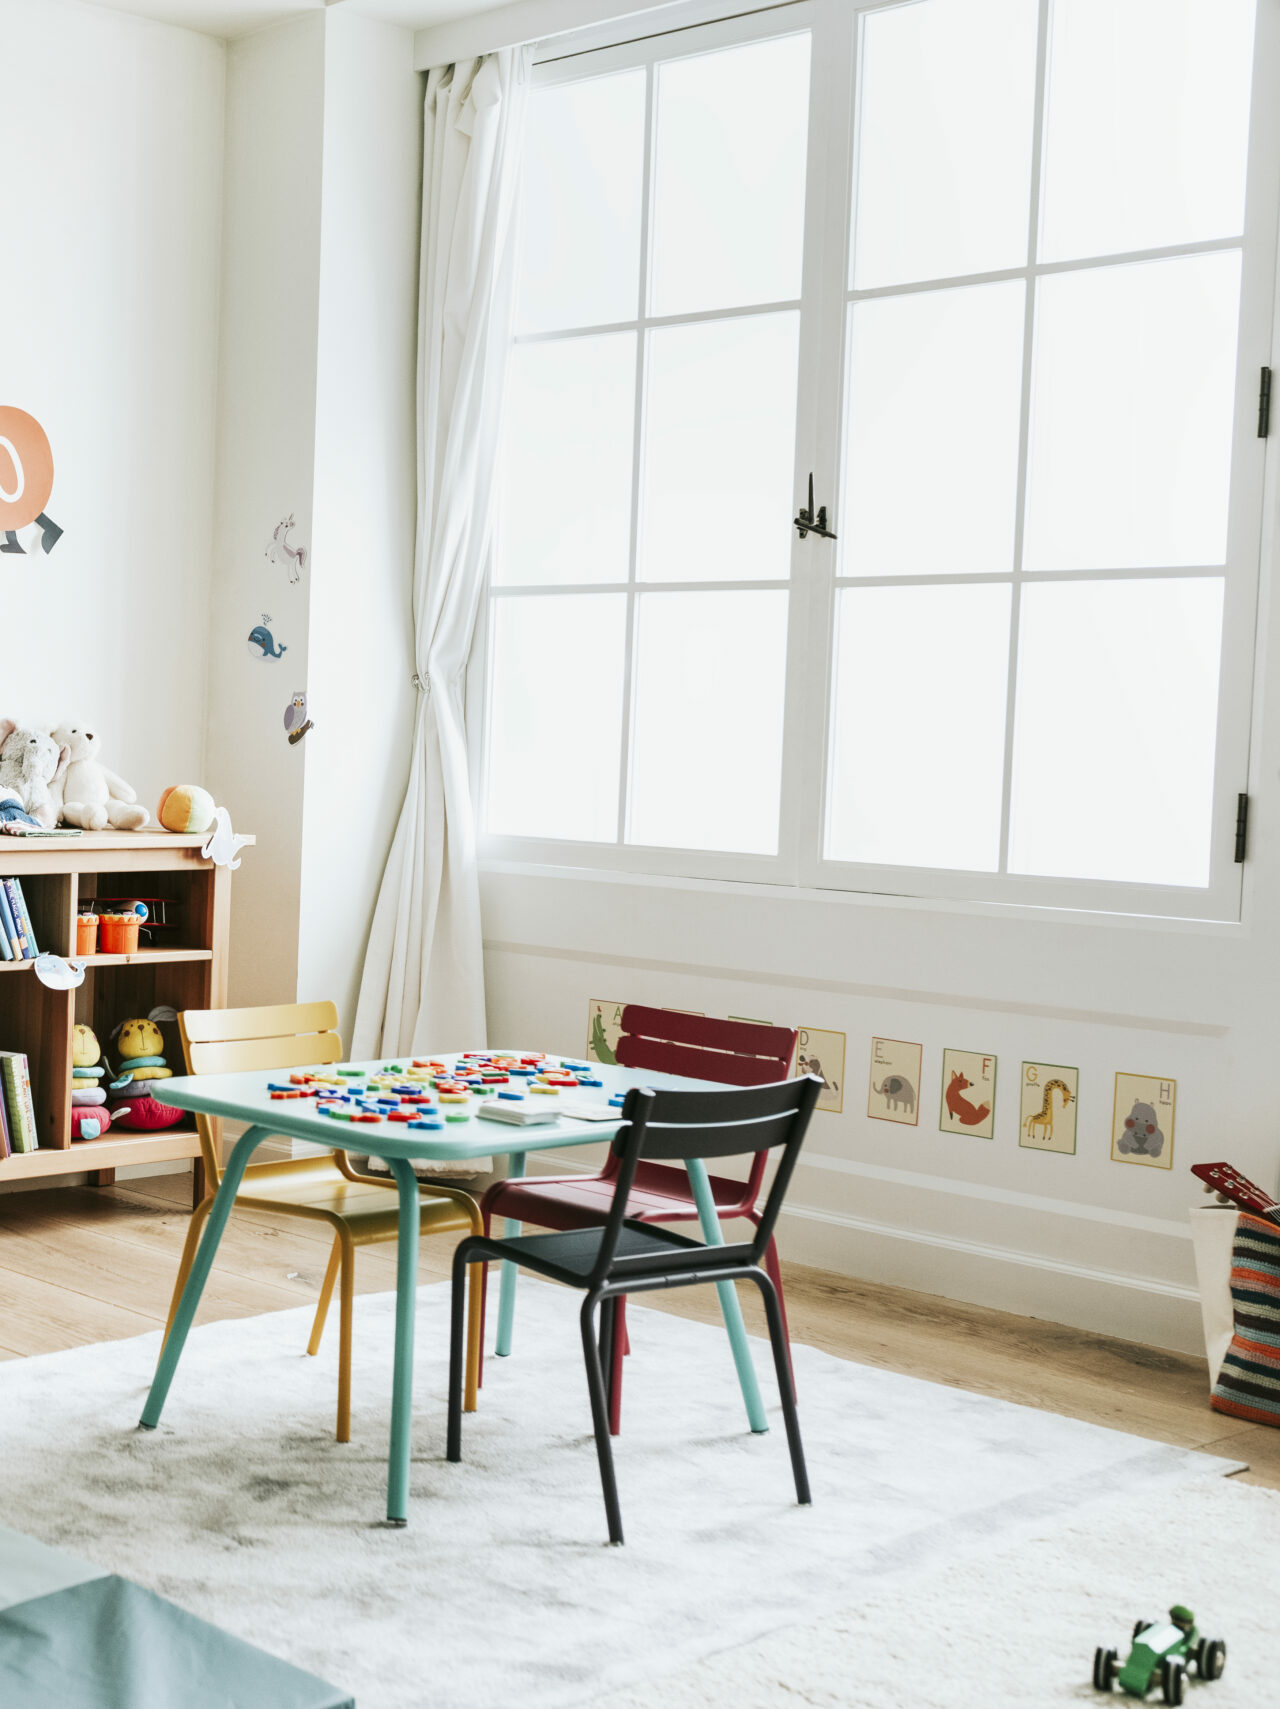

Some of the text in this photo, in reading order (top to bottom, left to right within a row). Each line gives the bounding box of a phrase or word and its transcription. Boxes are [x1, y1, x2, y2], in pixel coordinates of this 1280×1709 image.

[613, 1005, 623, 1021] A
[800, 1030, 809, 1046] D
[875, 1040, 885, 1059] E
[982, 1057, 992, 1075] F
[1025, 1065, 1038, 1082] G
[1160, 1081, 1170, 1100] H
